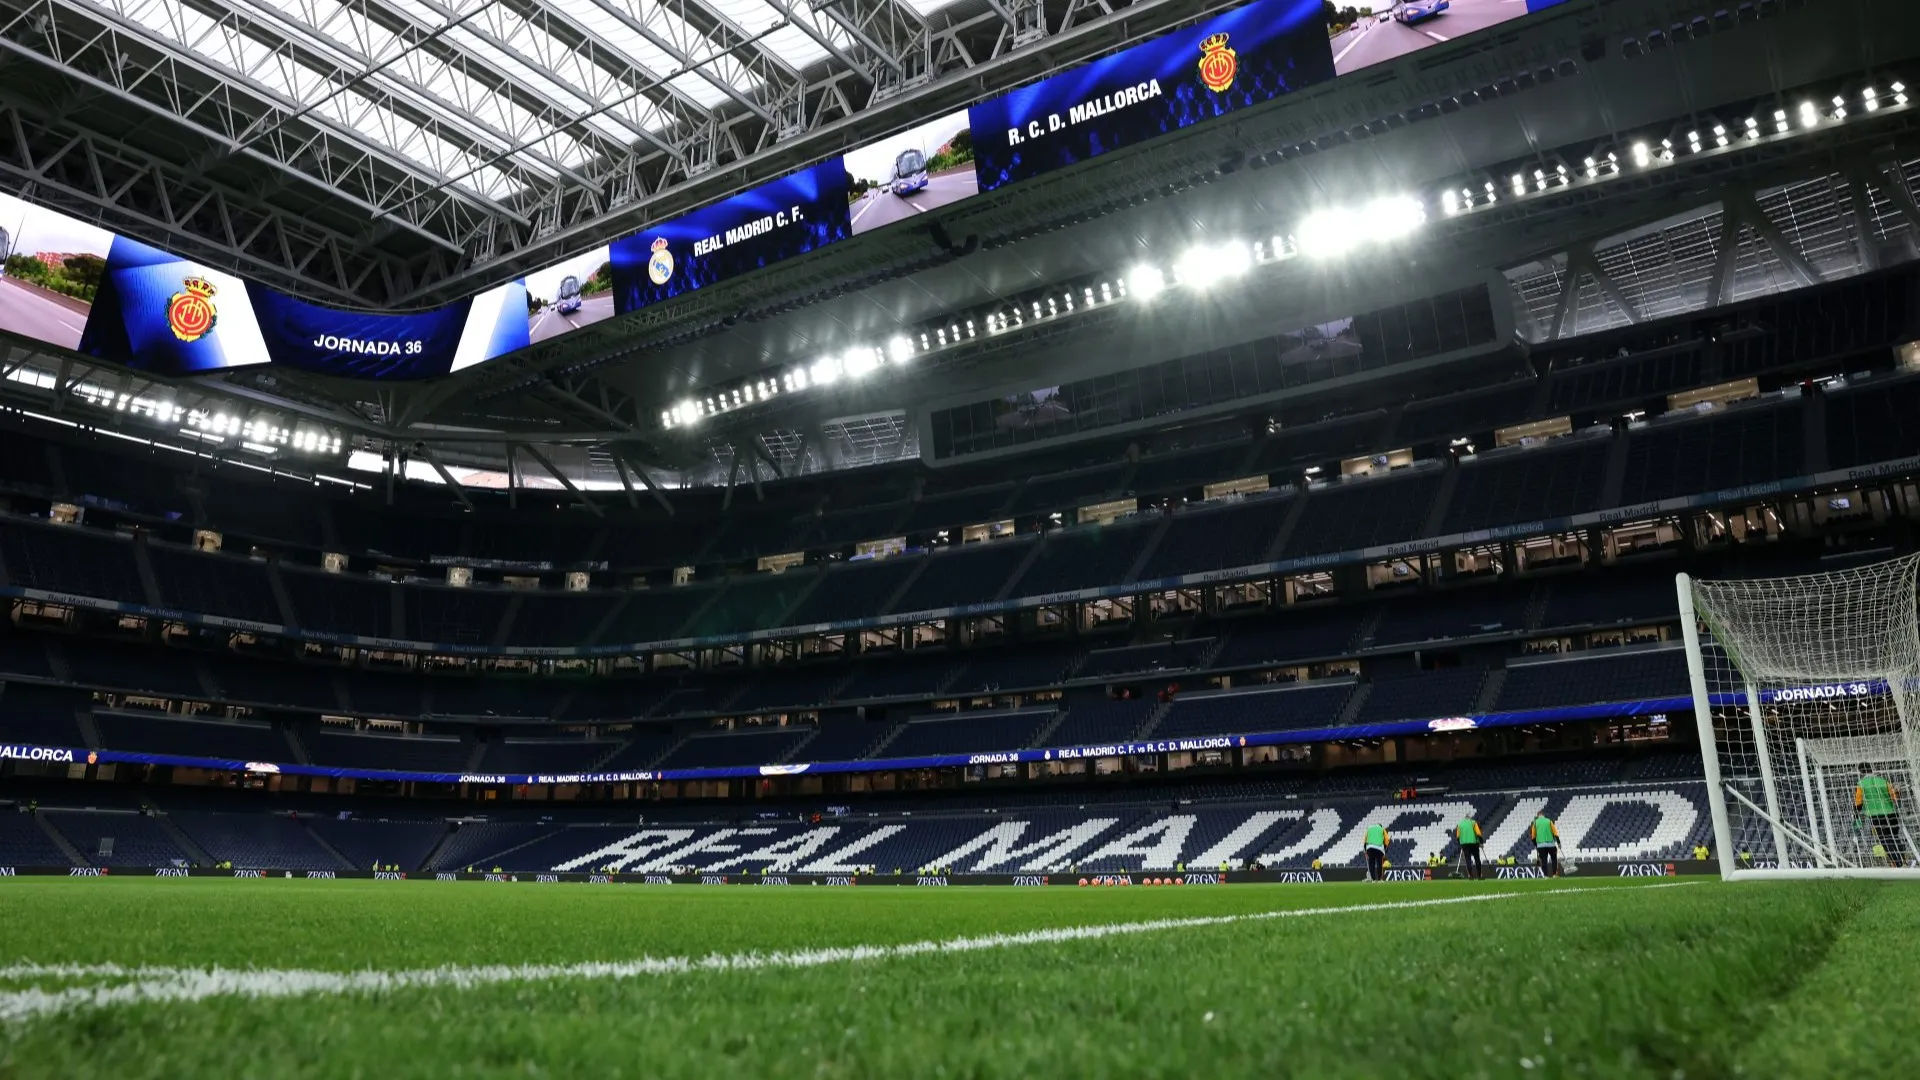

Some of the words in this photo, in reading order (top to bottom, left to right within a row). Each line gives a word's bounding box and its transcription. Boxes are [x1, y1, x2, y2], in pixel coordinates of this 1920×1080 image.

[1008, 127, 1024, 146] R.
[1028, 120, 1044, 139] C.
[1048, 113, 1066, 132] D.
[1069, 78, 1162, 125] MALLORCA
[693, 234, 724, 257] REAL
[725, 215, 774, 246] MADRID
[776, 211, 789, 228] C.
[791, 205, 804, 222] F.
[313, 334, 401, 355] JORNADA
[405, 340, 422, 354] 36
[1388, 545, 1405, 555] Real
[1408, 540, 1439, 551] Madrid
[1774, 685, 1846, 702] JORNADA
[1849, 684, 1868, 696] 36
[0, 745, 74, 762] ALLORCA
[1058, 749, 1082, 758] REAL
[1082, 746, 1116, 757] MADRID
[1118, 746, 1126, 754] C.
[1128, 745, 1136, 754] F.
[1147, 744, 1156, 752] R.
[1158, 742, 1167, 752] C.
[1169, 742, 1178, 750] D.
[1180, 738, 1232, 750] MALLORCA
[969, 753, 1008, 764] JORNADA
[1009, 752, 1019, 762] 36
[458, 775, 496, 784] JORNADA
[538, 775, 556, 784] REAL
[557, 774, 580, 784] MADRID
[620, 772, 652, 781] MALLORCA
[550, 825, 907, 873] REAL
[919, 791, 1699, 873] MADRID
[155, 868, 190, 878] ZEGNA
[307, 871, 336, 880] ZEGNA
[436, 873, 457, 882] ZEGNA
[1280, 872, 1324, 883] ZEGNA
[1496, 866, 1546, 879] ZEGNA
[536, 875, 560, 883] ZEGNA
[645, 876, 670, 884] ZEGNA
[762, 876, 789, 886] ZEGNA
[917, 876, 948, 886] ZEGNA
